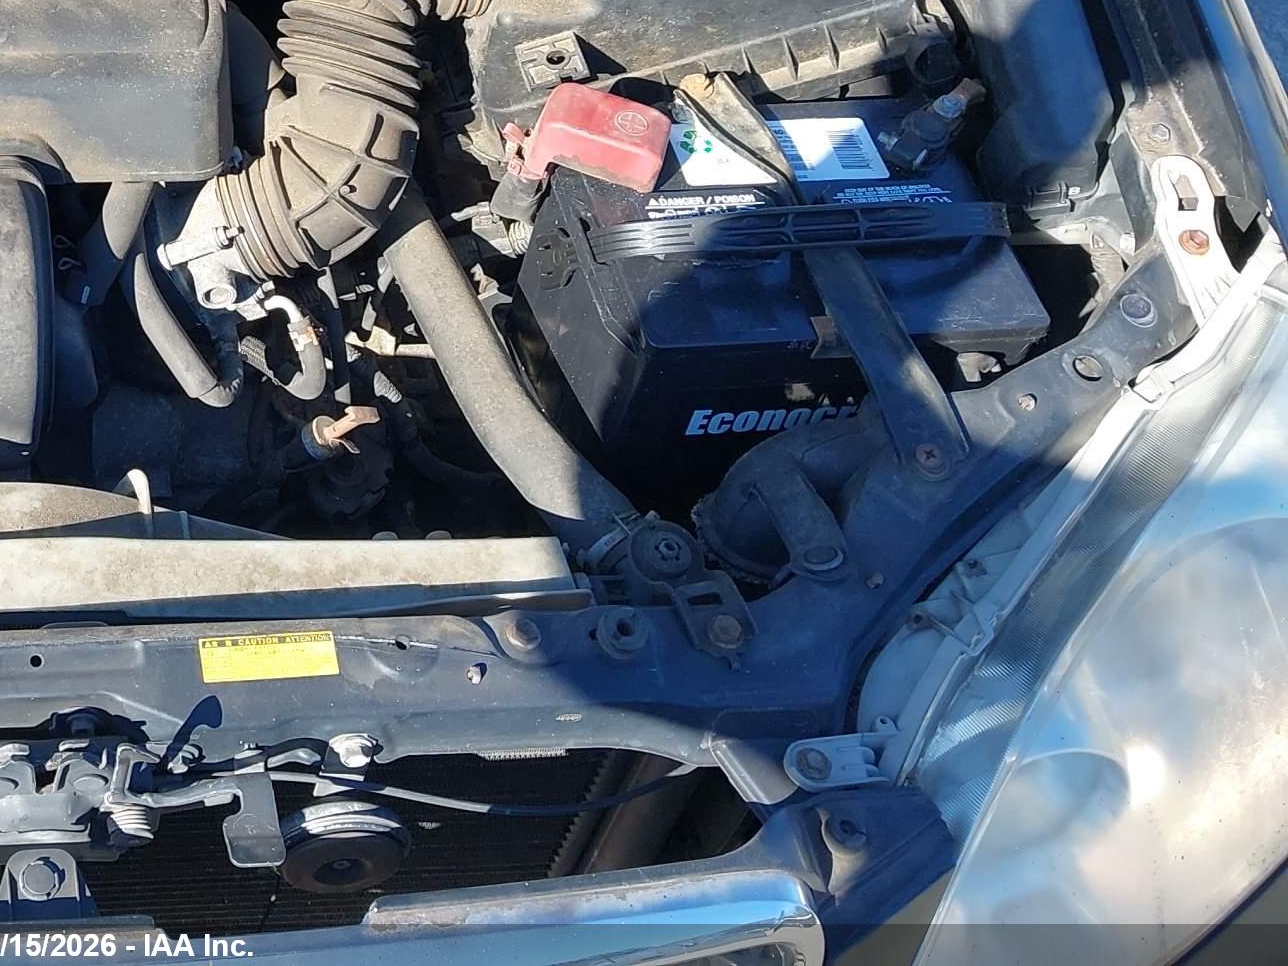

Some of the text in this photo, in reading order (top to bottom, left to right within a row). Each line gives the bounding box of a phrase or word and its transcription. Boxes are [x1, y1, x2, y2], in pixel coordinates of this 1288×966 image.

[660, 195, 706, 206] DANGER
[713, 193, 756, 203] POISON
[238, 636, 279, 646] CAUTION
[285, 633, 330, 643] ATTENTION
